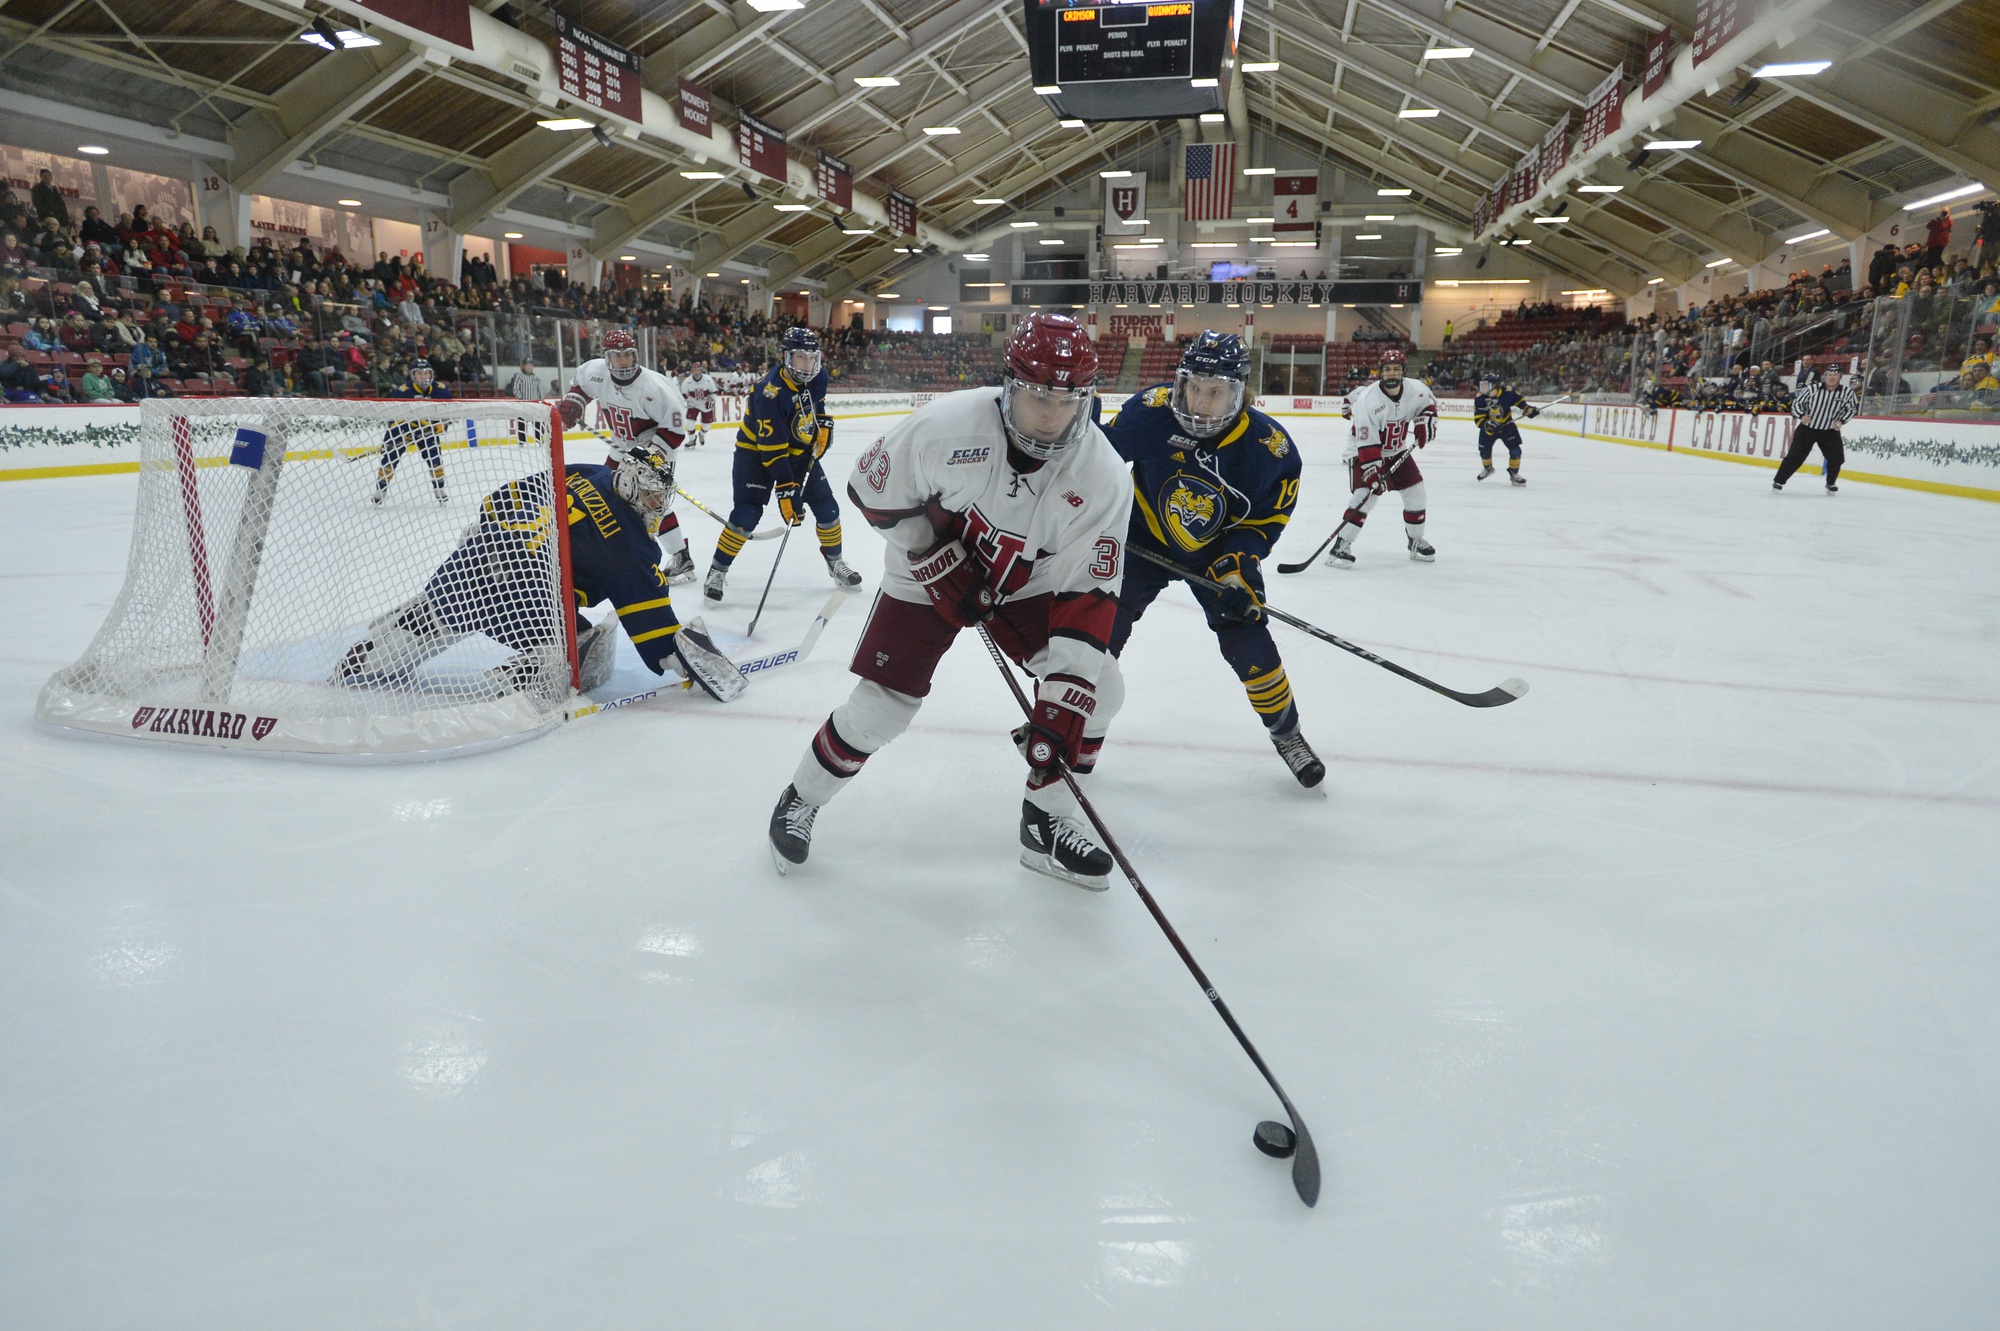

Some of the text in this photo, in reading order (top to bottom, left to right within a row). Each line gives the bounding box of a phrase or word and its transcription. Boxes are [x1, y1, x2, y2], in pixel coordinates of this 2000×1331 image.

[1063, 4, 1192, 22] CRIMSON QUINNIPIAC
[1107, 31, 1128, 40] PERIOD
[1147, 38, 1187, 48] PLYR PENALTY
[591, 38, 627, 63] TOURNAMENT
[1060, 43, 1099, 53] PLYR PENALTY
[1103, 51, 1121, 59] SHOTS
[1130, 50, 1145, 58] GOAL
[681, 89, 710, 112] WOMEN'S
[684, 107, 708, 126] HOCKEY
[203, 176, 220, 191] 18
[1118, 190, 1133, 212] H
[1286, 200, 1298, 219] 4
[278, 224, 307, 236] AWARDS
[427, 220, 439, 232] 17
[1890, 224, 1899, 236] 6
[571, 250, 582, 259] 16
[1780, 254, 1787, 264] 7
[674, 269, 684, 277] 15
[1089, 283, 1334, 304] HARVARD HOCKEY
[1110, 315, 1163, 327] STUDENT
[1110, 326, 1163, 336] SECTION
[1055, 337, 1071, 349] 33
[1195, 356, 1219, 364] CCM
[607, 404, 637, 443] H
[672, 412, 682, 427] 6
[1595, 407, 1658, 441] HARVARD
[757, 419, 774, 437] 25
[1383, 419, 1406, 452] H
[1170, 434, 1198, 446] ECAC
[1691, 413, 1797, 459] CRIMSON
[951, 447, 990, 459] ECAC
[956, 455, 989, 465] HOCKEY
[858, 437, 890, 493] 33
[1273, 478, 1300, 510] 19
[1088, 536, 1121, 581] 3
[150, 708, 247, 740] HARVARD
